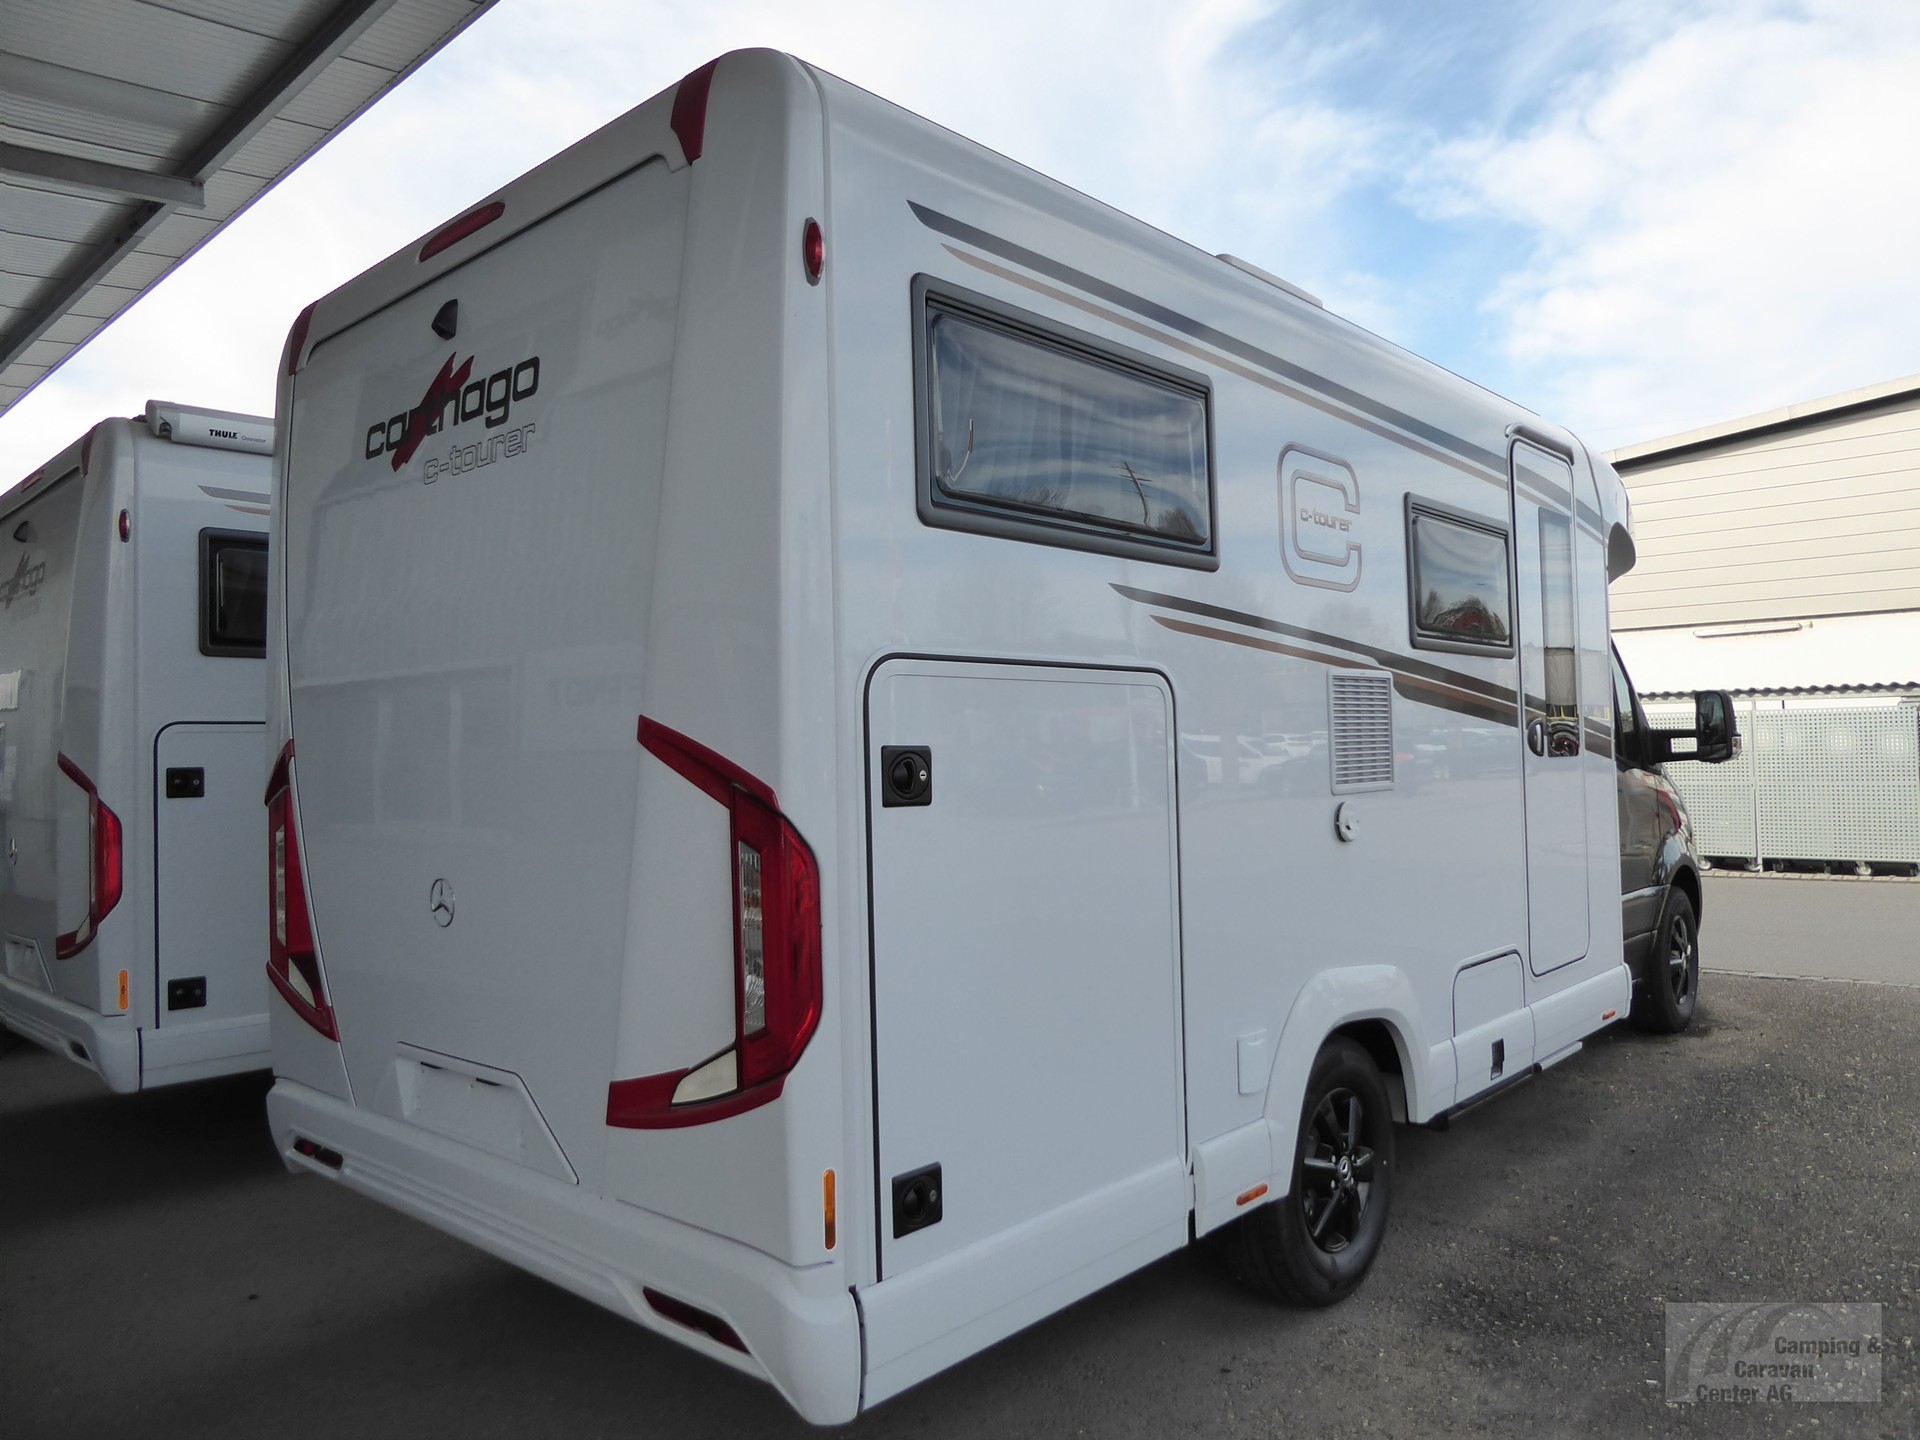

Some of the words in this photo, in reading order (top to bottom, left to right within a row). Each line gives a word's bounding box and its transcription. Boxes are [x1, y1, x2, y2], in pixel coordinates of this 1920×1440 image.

[365, 355, 541, 461] carthago
[208, 428, 239, 441] THULE
[422, 422, 537, 486] c-tourer
[1299, 506, 1352, 533] c-tourer
